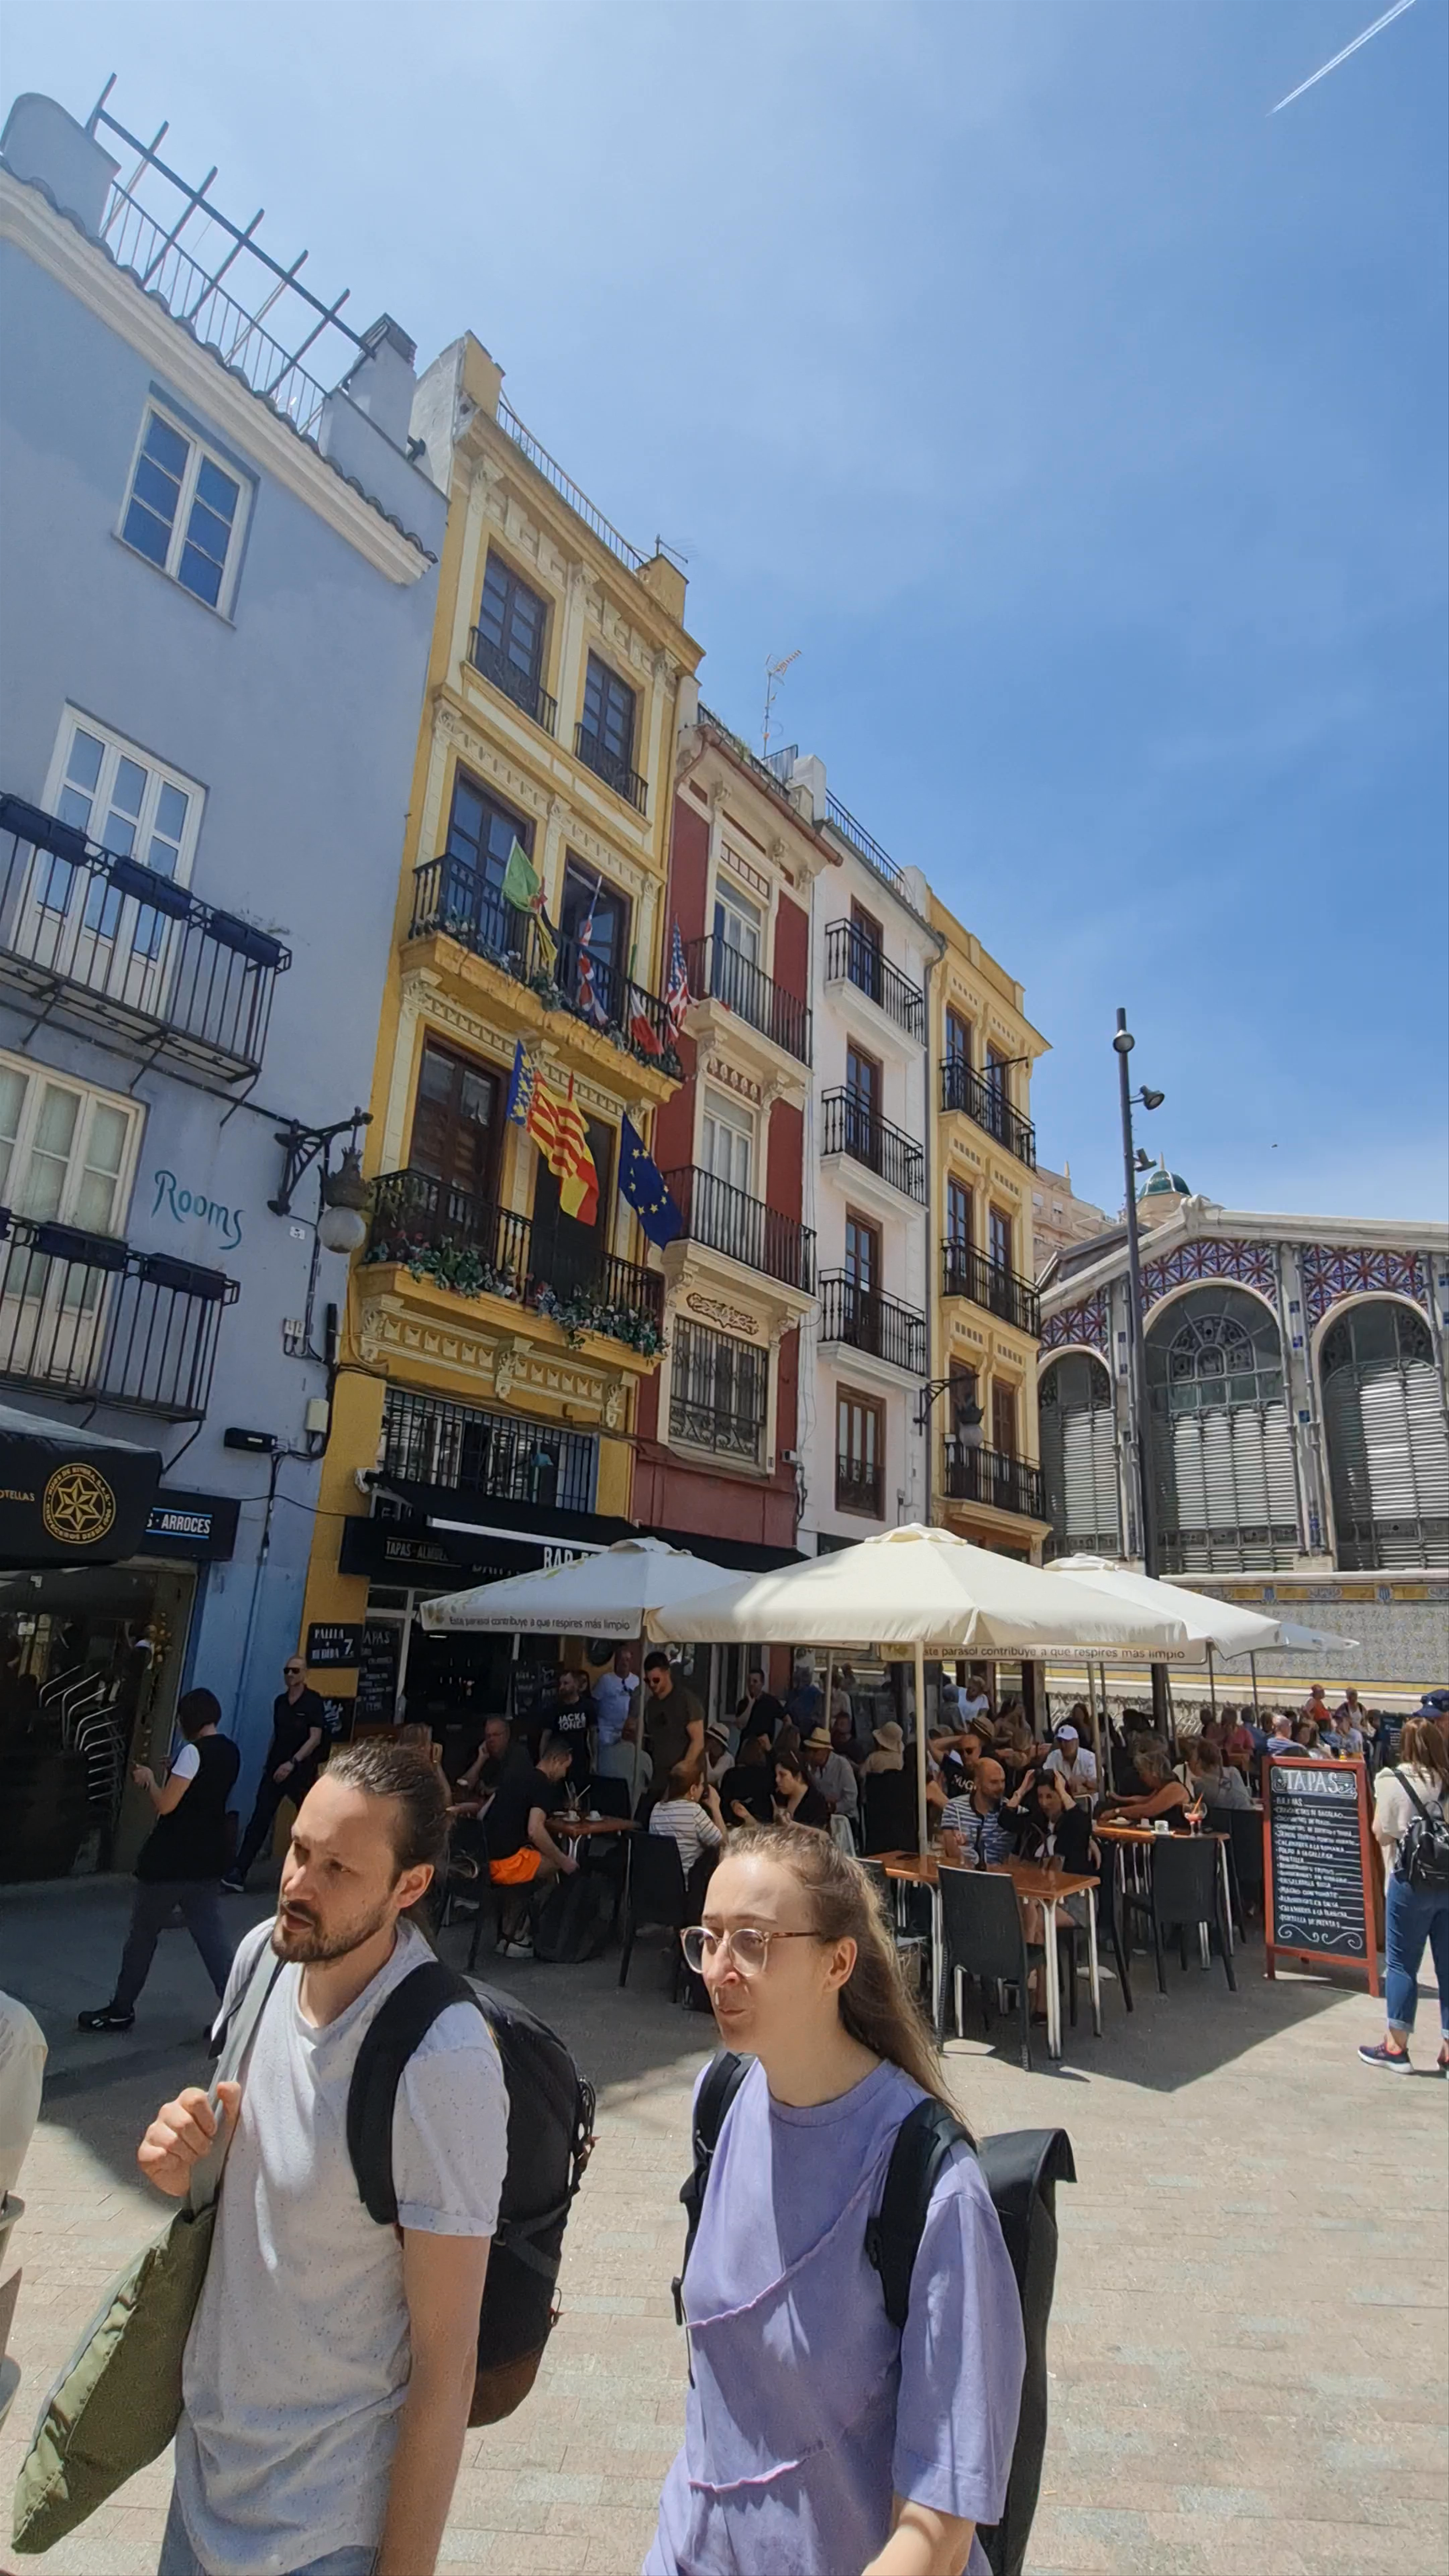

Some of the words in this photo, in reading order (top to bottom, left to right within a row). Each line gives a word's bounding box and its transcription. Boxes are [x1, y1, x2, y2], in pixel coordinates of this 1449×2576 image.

[151, 1170, 246, 1250] Rooms
[161, 1514, 211, 1534] ARROCES
[386, 1541, 411, 1557] TAPAS
[491, 1615, 528, 1628] contribuye
[552, 1618, 583, 1630] respires
[604, 1619, 630, 1631] limpio
[363, 1631, 390, 1645] APAS
[924, 1647, 938, 1656] ste
[942, 1647, 978, 1658] parasol
[981, 1647, 1036, 1658] contribuye
[1050, 1648, 1071, 1658] que
[1074, 1647, 1117, 1658] respires
[1149, 1650, 1185, 1661] limpio
[1282, 1770, 1339, 1793] TAPAS
